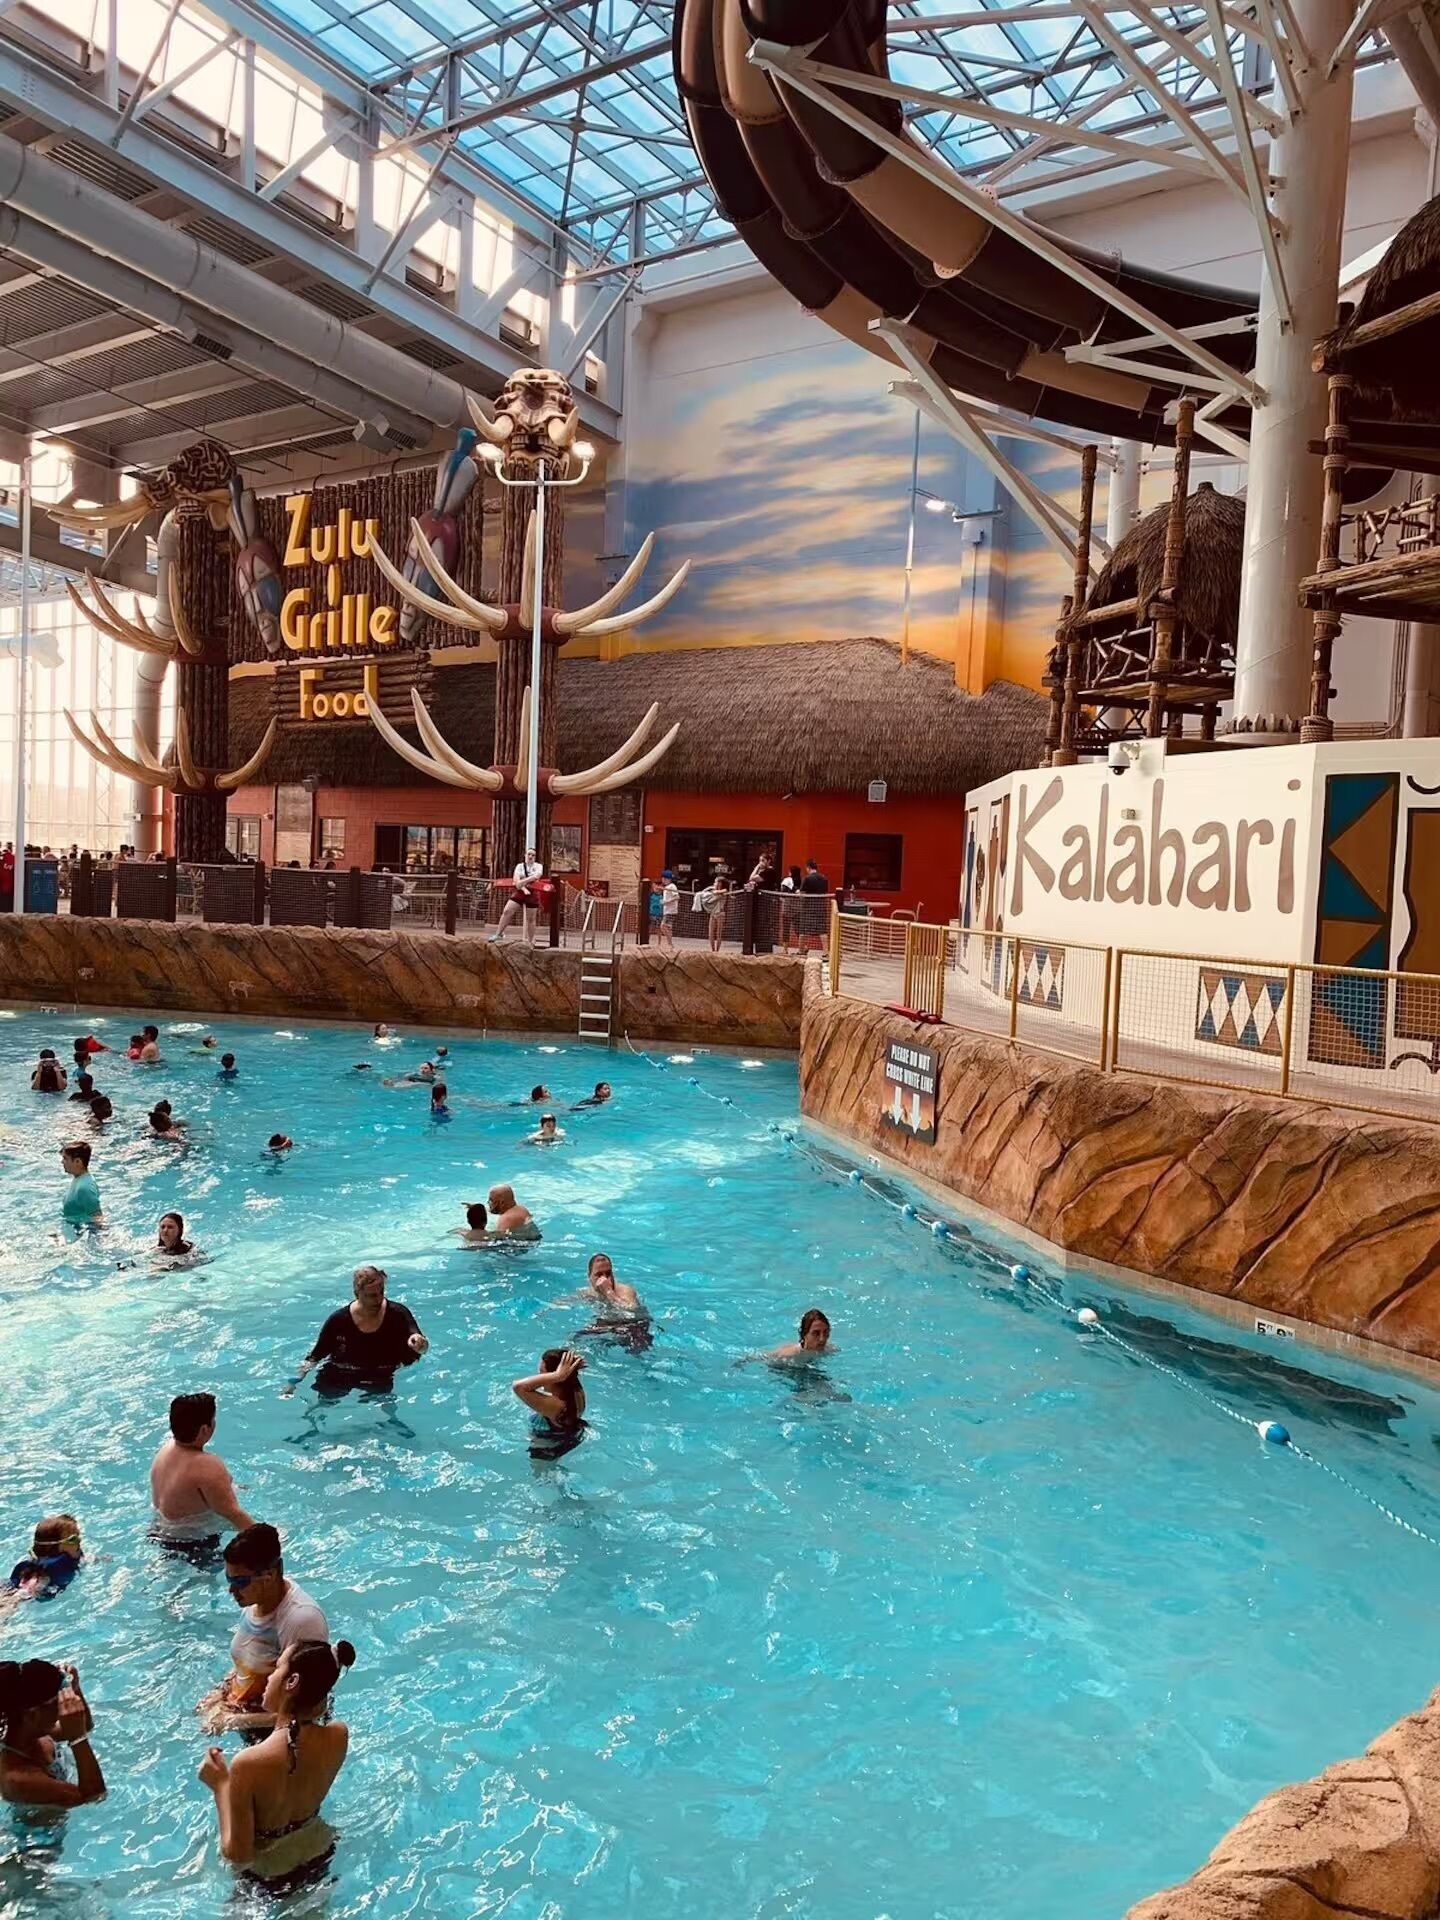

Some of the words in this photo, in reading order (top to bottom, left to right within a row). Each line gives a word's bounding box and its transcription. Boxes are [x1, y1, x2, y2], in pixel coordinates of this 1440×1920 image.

[283, 494, 380, 567] Zulu
[280, 564, 397, 650] Grille
[300, 665, 379, 720] Food
[1010, 775, 1302, 916] Kalahari
[891, 1044, 909, 1063] PLEASE
[918, 1053, 930, 1071] NOT
